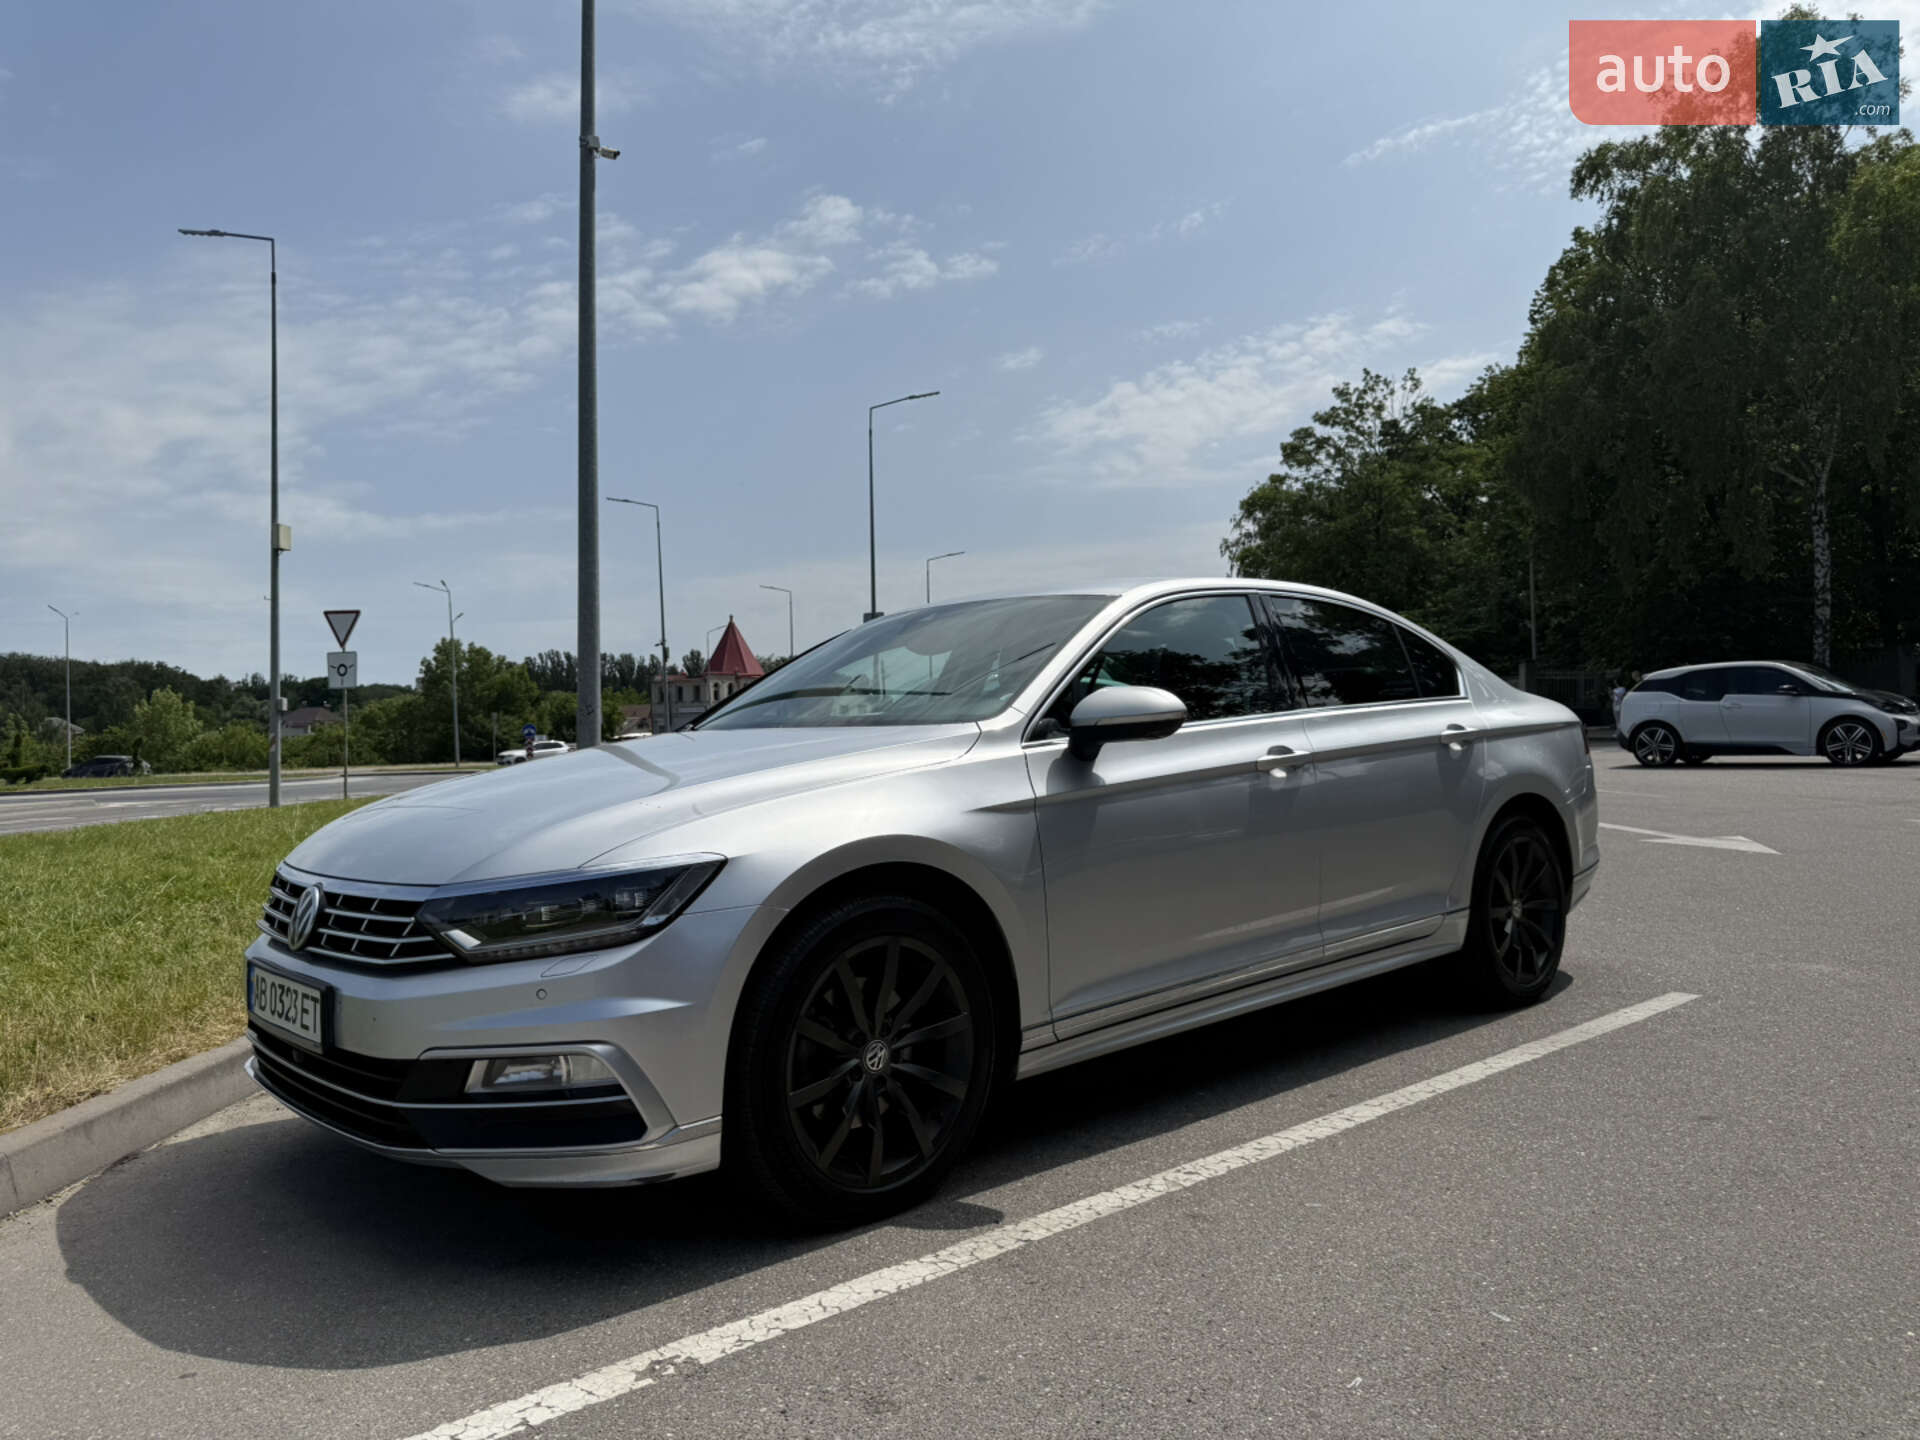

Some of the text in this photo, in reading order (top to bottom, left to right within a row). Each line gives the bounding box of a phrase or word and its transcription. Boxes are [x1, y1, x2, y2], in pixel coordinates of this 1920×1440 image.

[254, 973, 319, 1035] AB 0323 ET
